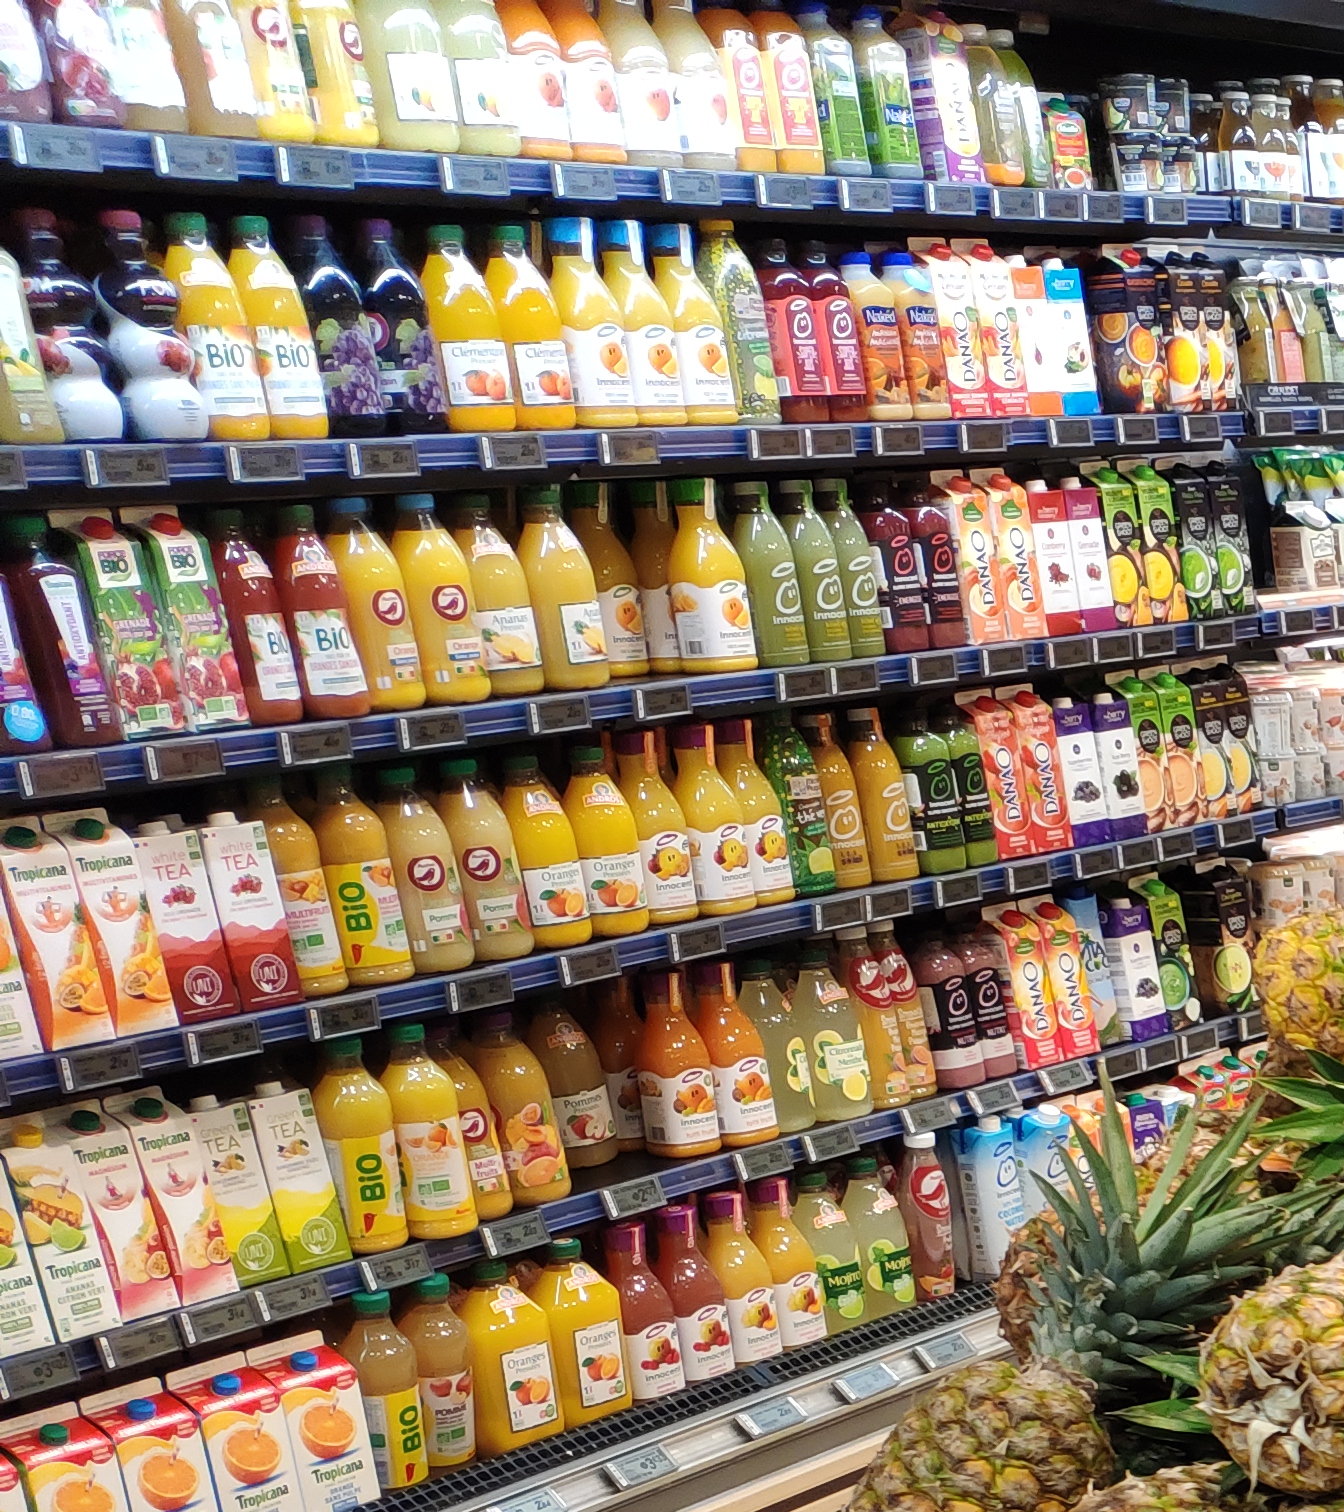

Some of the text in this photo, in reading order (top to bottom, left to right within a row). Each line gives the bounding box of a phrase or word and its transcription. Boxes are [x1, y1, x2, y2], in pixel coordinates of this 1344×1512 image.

[953, 311, 976, 382] DANAO
[994, 311, 1016, 382] DANAO
[969, 528, 995, 606] DANAO
[1007, 526, 1035, 603] DANAO
[492, 614, 528, 626] Ananas
[315, 626, 351, 652] BiO
[995, 747, 1022, 821] DANAO
[1034, 742, 1059, 815] DANAO
[151, 849, 187, 863] white
[220, 840, 253, 854] white
[7, 862, 67, 883] Tropicana
[75, 853, 133, 873] Tropicana
[152, 862, 191, 882] TEA
[220, 853, 259, 873] TEA
[593, 859, 636, 873] Oranges
[338, 880, 373, 933] BiO
[1023, 961, 1049, 1032] DANAO
[1058, 952, 1085, 1022] DANAO
[138, 1131, 191, 1152] Tropicana
[269, 1121, 306, 1140] TEA
[73, 1144, 128, 1164] Tropicana
[202, 1135, 242, 1155] TEA
[356, 1153, 386, 1202] BiO
[45, 1257, 102, 1280] Tropicana
[0, 1275, 33, 1294] picana
[579, 1329, 617, 1346] Oranges
[507, 1352, 546, 1370] Oranges
[399, 1405, 422, 1453] BiO
[311, 1458, 364, 1484] Tropicana
[235, 1484, 289, 1510] Tropicana
